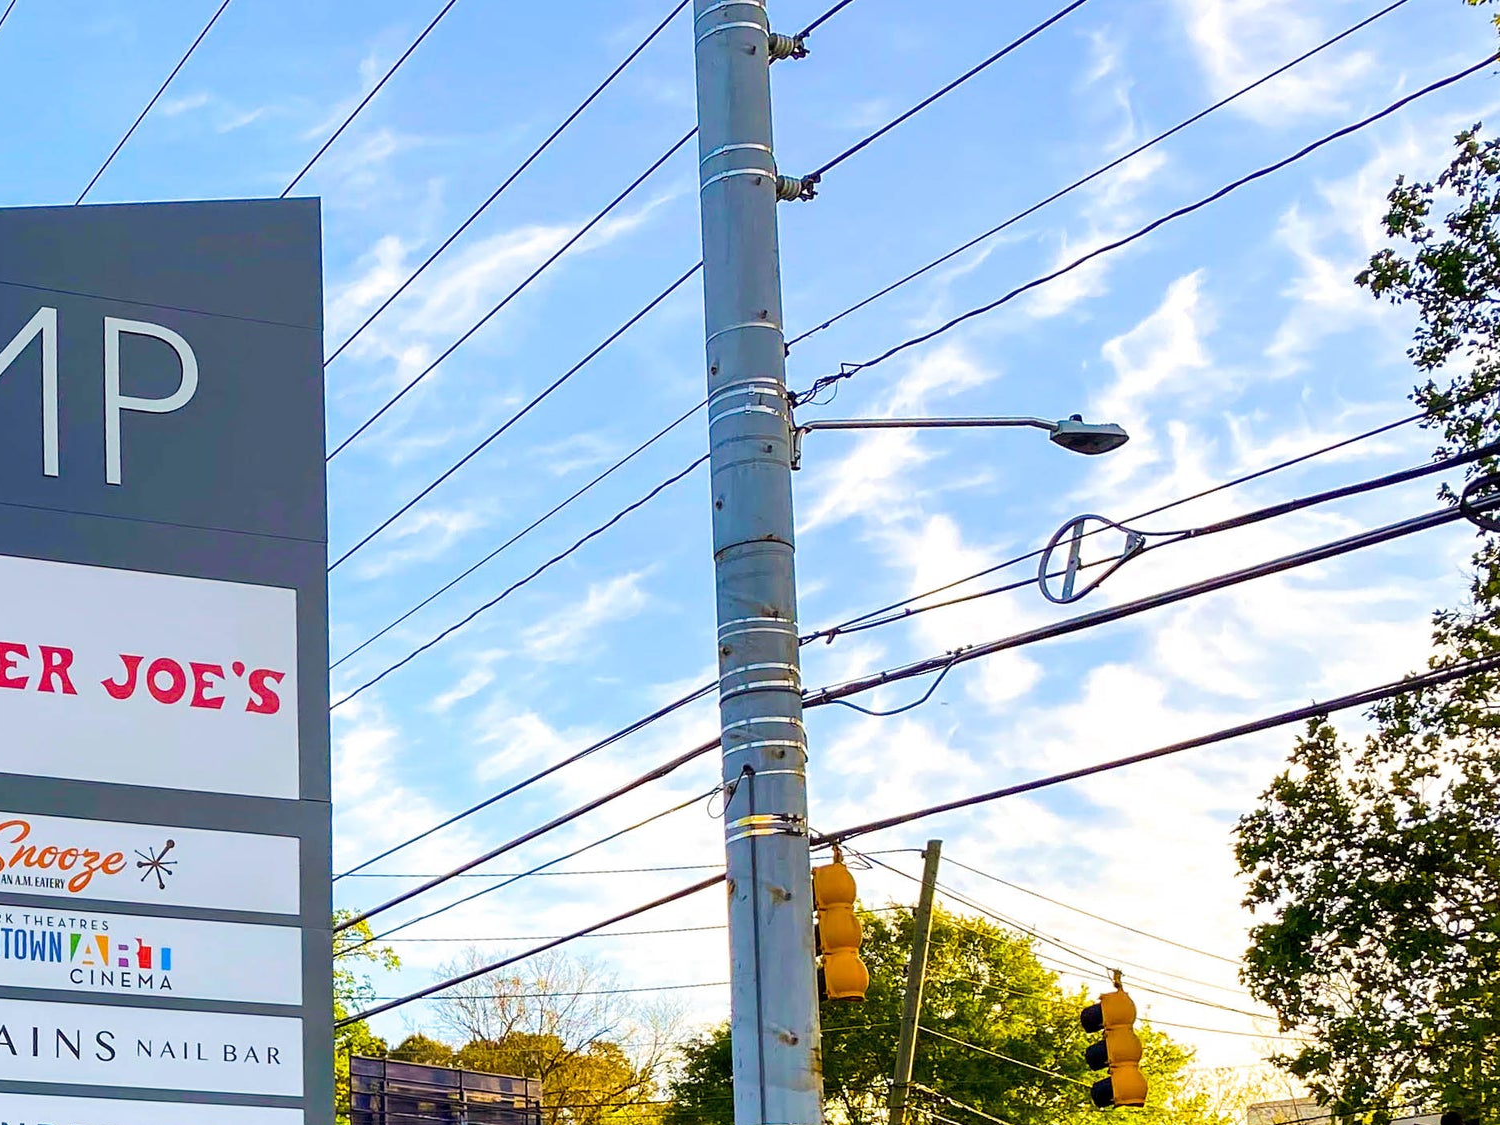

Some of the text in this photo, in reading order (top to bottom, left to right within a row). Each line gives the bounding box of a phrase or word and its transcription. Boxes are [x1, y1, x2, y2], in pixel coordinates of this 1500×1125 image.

[100, 653, 286, 715] JOE'S
[0, 874, 66, 890] AN A.M. EATERY
[23, 914, 109, 931] THEATRES
[70, 967, 173, 991] CINEMA
[136, 1039, 209, 1061] NAIL
[223, 1044, 282, 1065] BAR
